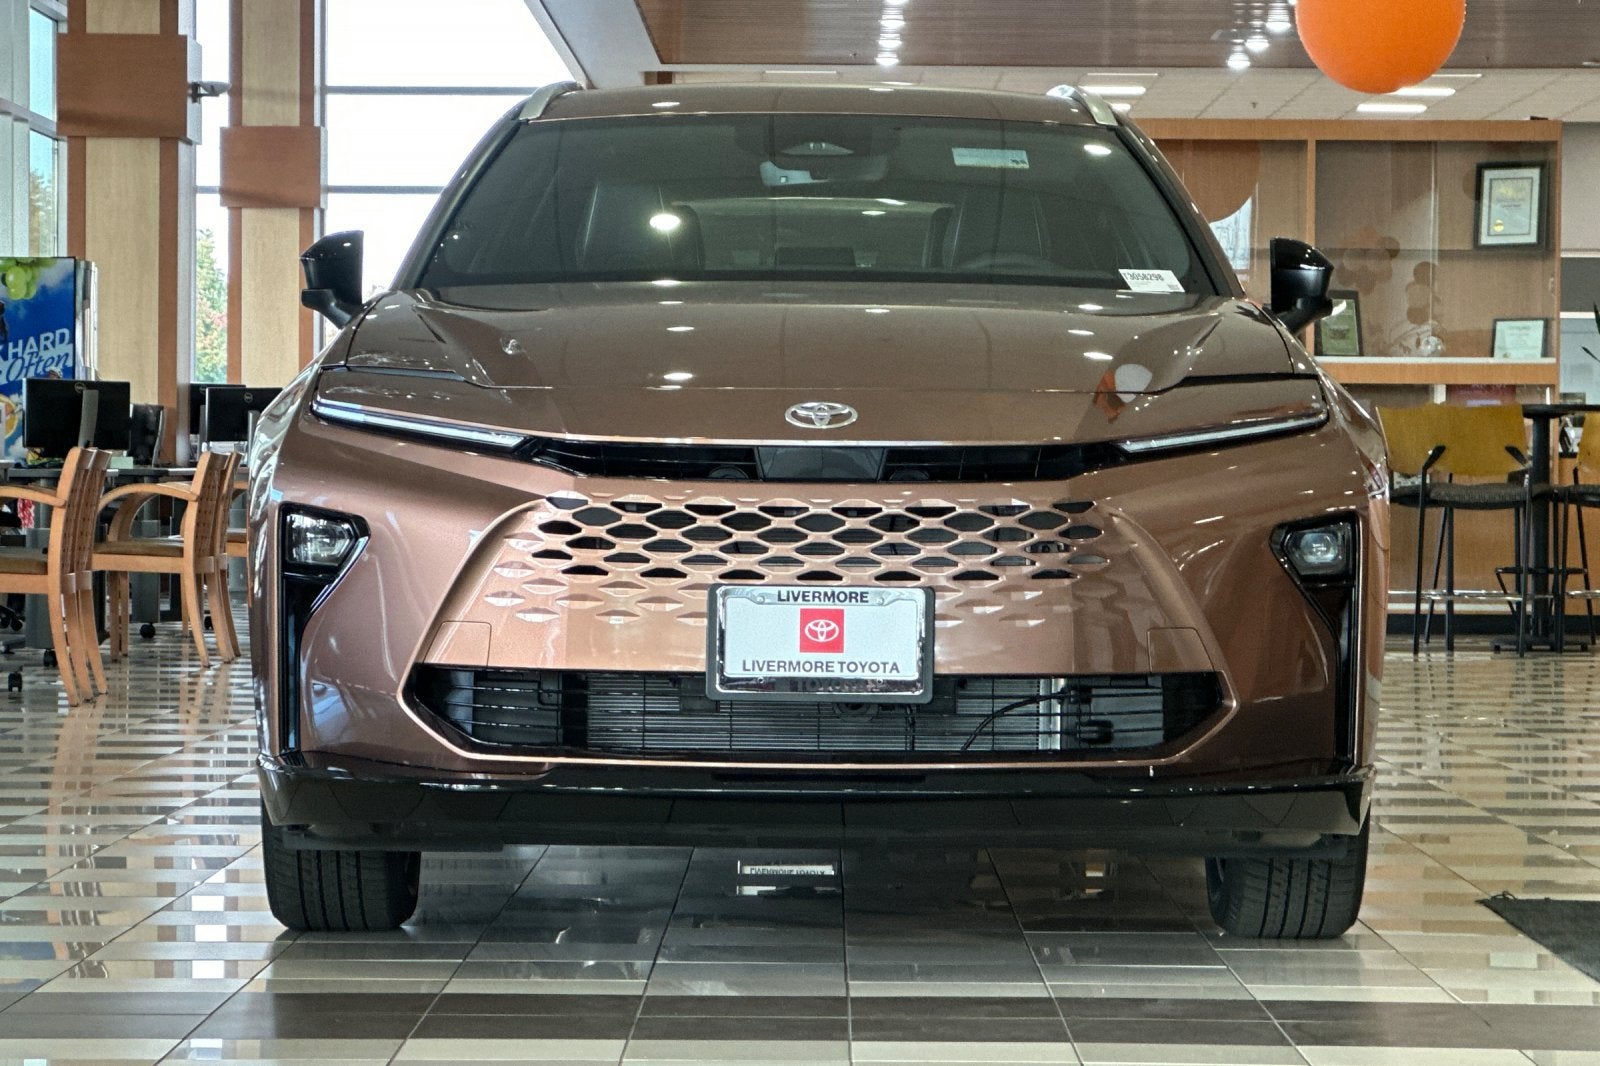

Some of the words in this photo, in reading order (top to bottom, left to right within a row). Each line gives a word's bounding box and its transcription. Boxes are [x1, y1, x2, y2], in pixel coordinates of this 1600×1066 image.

[8, 328, 70, 361] HARD
[6, 353, 69, 382] Often
[777, 590, 869, 603] LIVERMORE
[742, 660, 834, 673] LIVERMORE
[838, 661, 899, 673] TOYOTA
